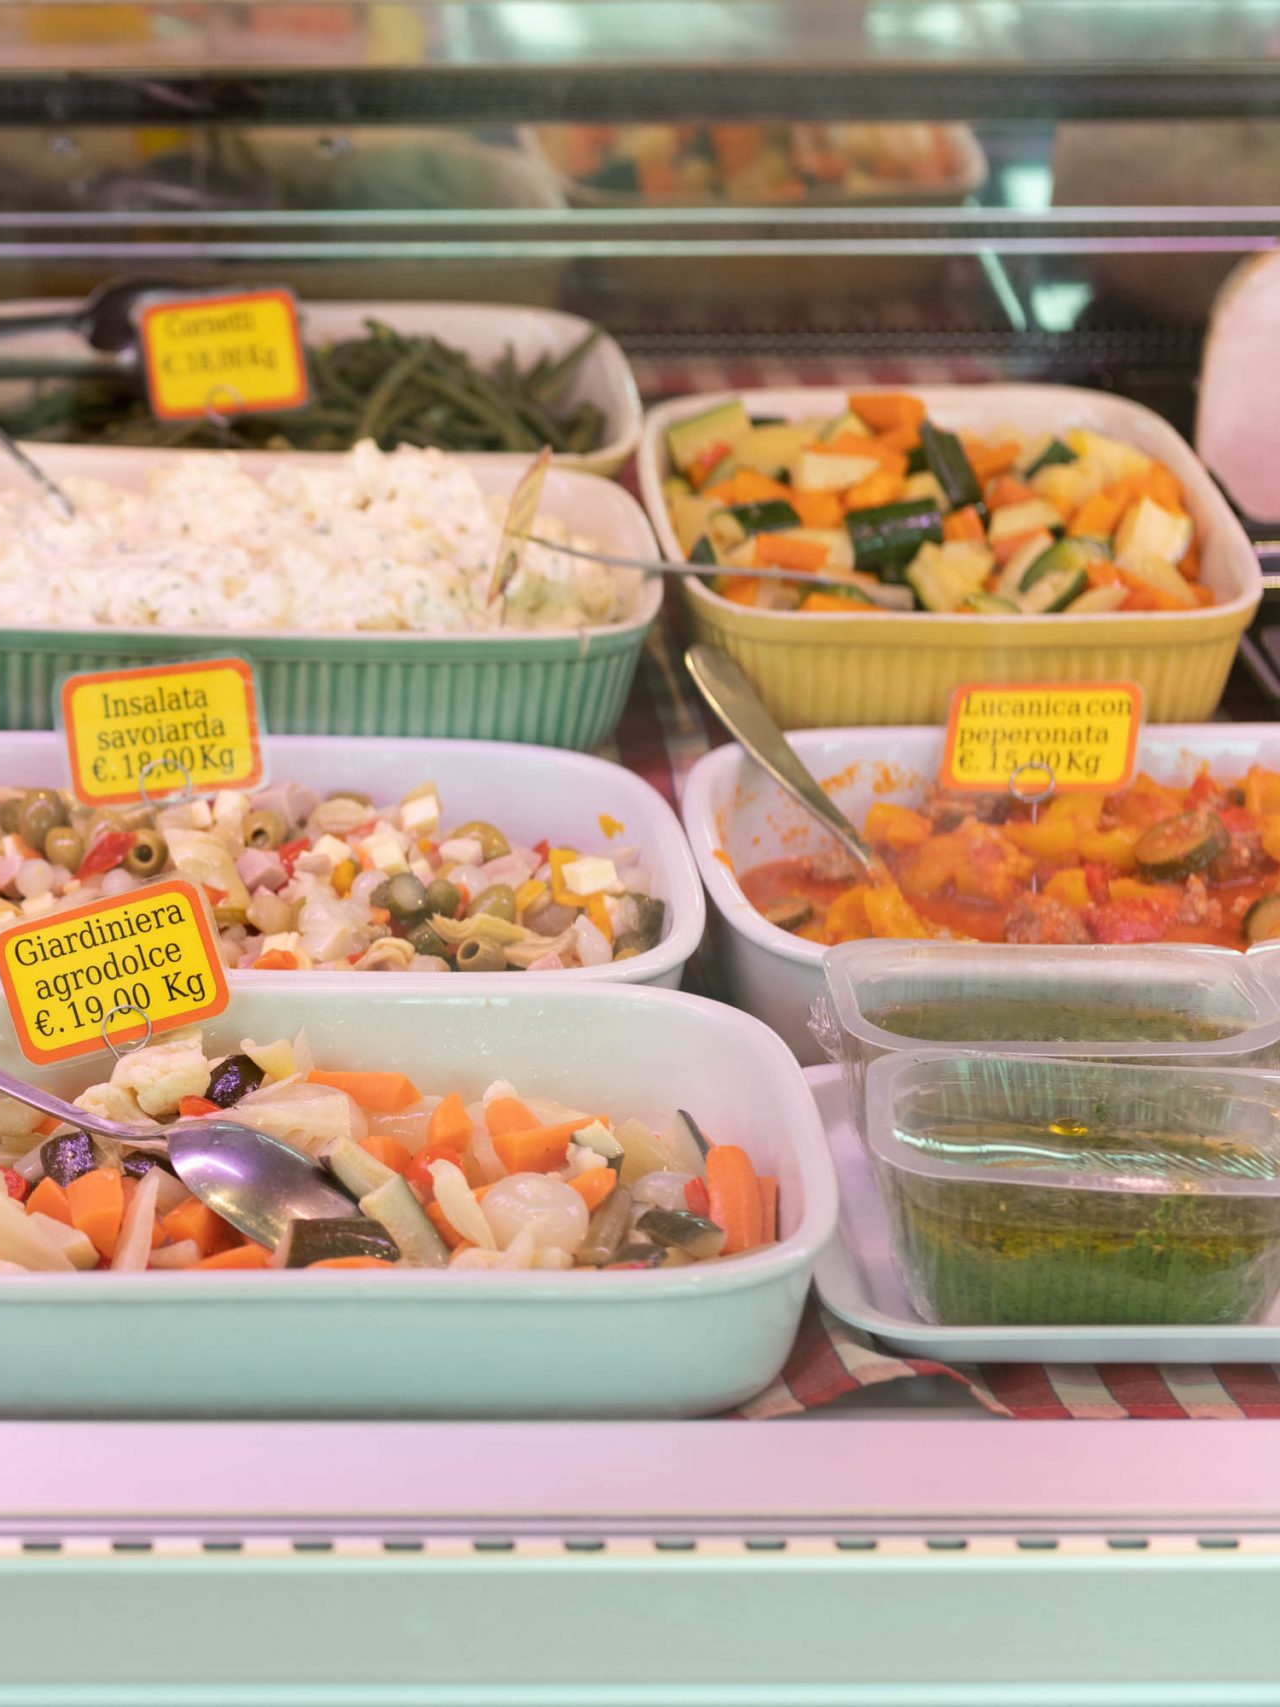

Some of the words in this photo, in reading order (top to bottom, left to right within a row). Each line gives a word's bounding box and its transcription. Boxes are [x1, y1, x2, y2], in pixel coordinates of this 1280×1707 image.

[101, 686, 208, 719] Insalata
[963, 693, 1081, 717] Lucanica
[96, 714, 226, 751] savoiarda
[959, 725, 1109, 750] peperonata
[14, 903, 186, 966] Giardiniera
[35, 941, 183, 1002] agrodolce
[161, 971, 206, 1003] Kg
